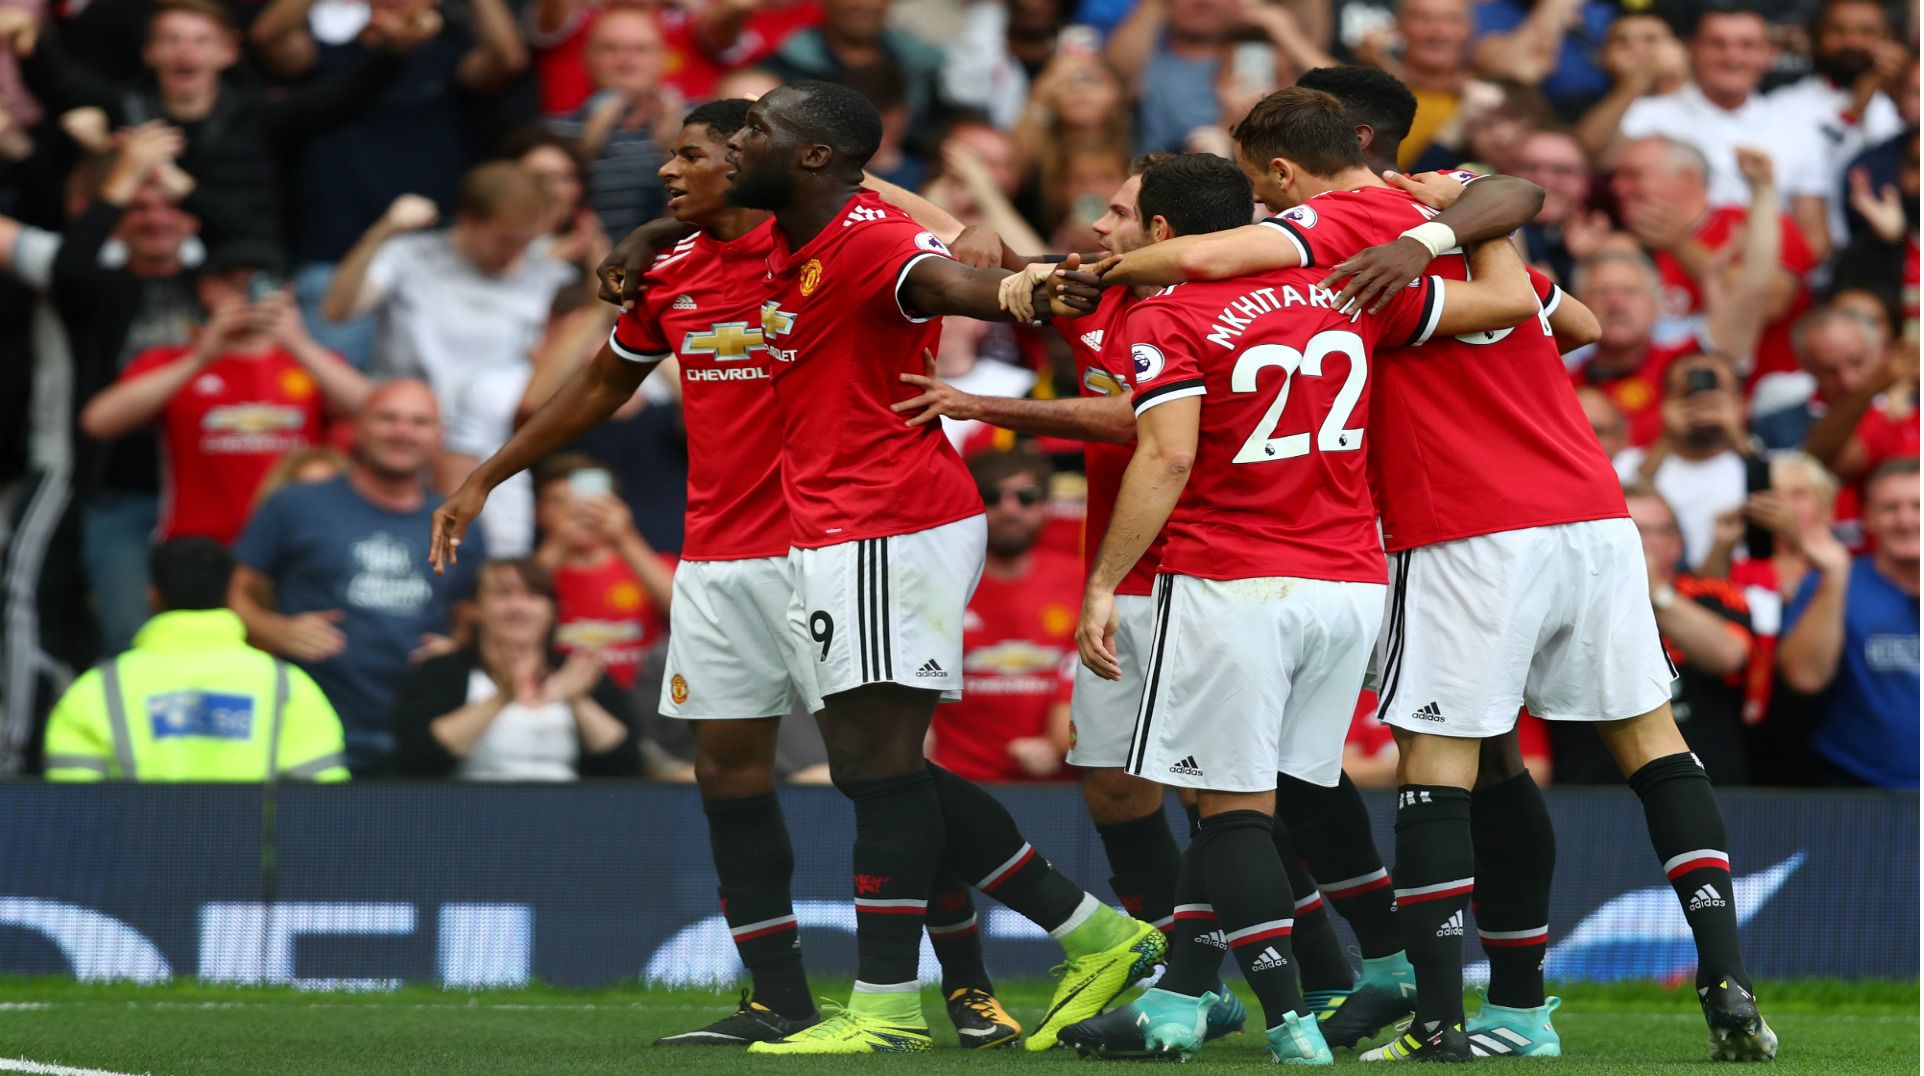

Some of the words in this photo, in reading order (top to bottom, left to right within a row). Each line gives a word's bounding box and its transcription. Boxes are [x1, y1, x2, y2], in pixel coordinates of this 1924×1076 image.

[1206, 283, 1362, 350] MKHITARY
[1231, 330, 1368, 464] 22
[810, 610, 834, 662] 9
[915, 668, 948, 678] adidas
[1411, 712, 1446, 723] adidas
[1169, 766, 1203, 777] adidas
[1689, 898, 1726, 911] adidas
[1194, 937, 1228, 950] adidas
[1251, 958, 1288, 972] adidas
